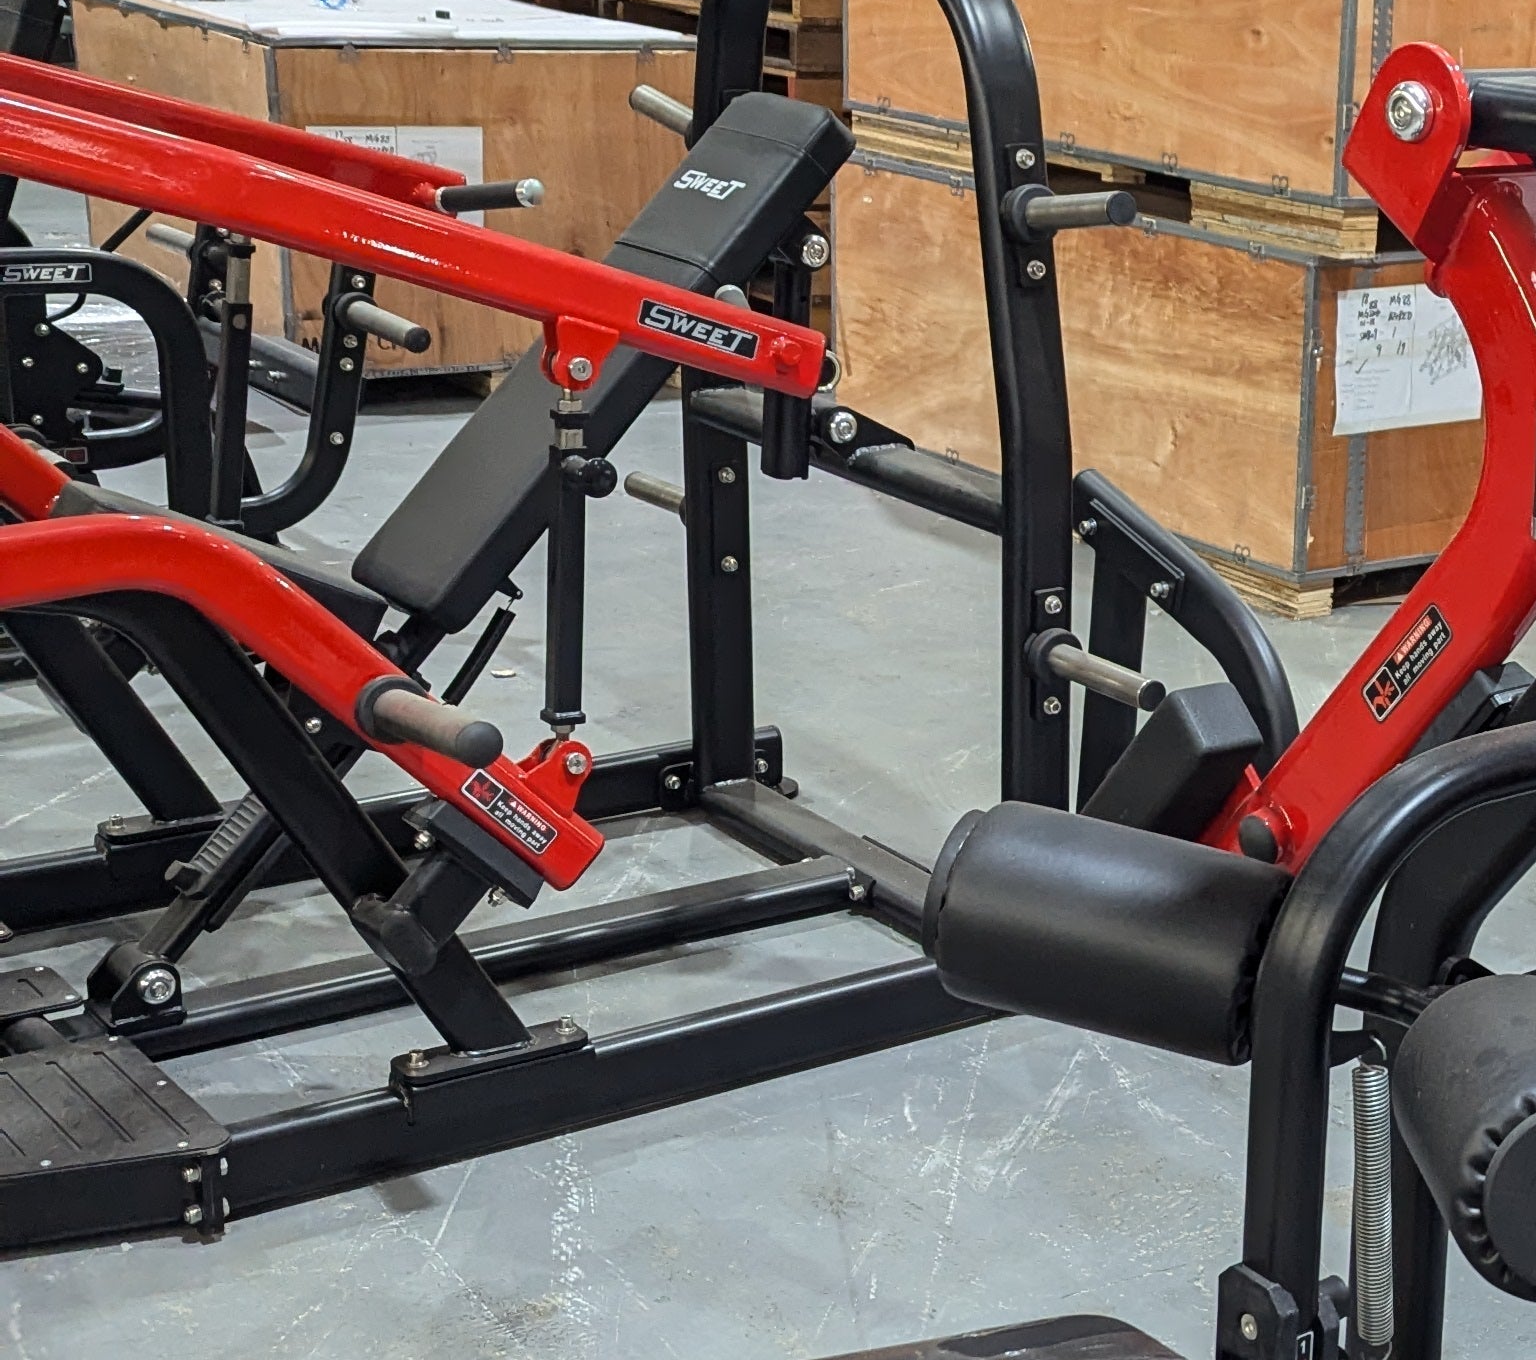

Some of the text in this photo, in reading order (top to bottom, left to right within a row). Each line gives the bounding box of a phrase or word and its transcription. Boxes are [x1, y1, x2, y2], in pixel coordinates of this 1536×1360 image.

[674, 169, 747, 200] SWEET
[3, 264, 87, 282] SWEET
[644, 305, 753, 352] SWEET
[1395, 620, 1443, 680] Keep hands away
[1402, 614, 1433, 655] WARNING
[1403, 632, 1446, 686] all moving part
[494, 810, 541, 849] all moving part
[496, 800, 548, 844] Keep hands away
[517, 805, 547, 831] WARNING
[1299, 1340, 1306, 1354] 1
